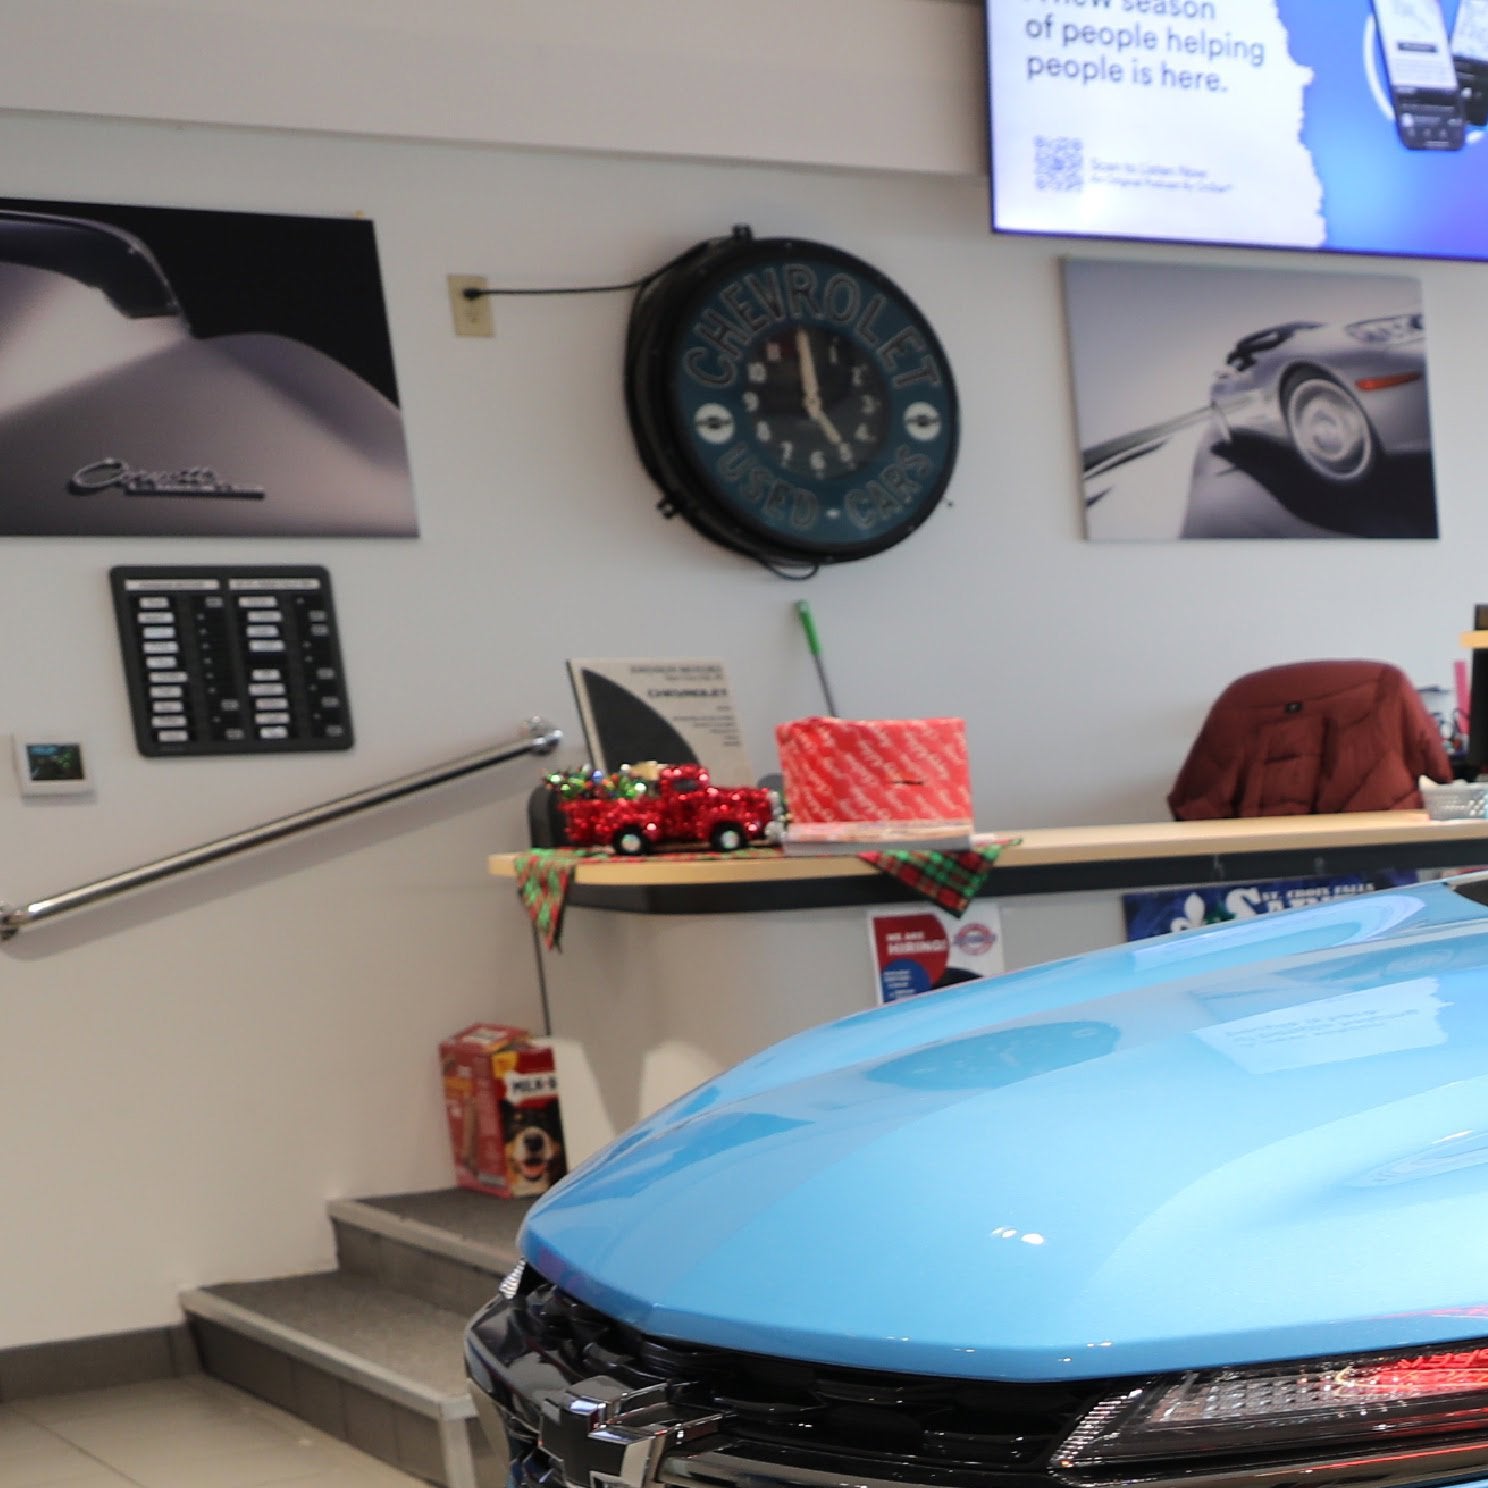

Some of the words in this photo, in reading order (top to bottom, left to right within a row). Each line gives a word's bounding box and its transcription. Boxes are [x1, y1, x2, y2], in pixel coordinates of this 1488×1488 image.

[1121, 0, 1215, 20] season
[1025, 13, 1053, 39] of
[1062, 22, 1158, 52] people
[1167, 25, 1265, 68] helping
[1027, 54, 1124, 85] people
[1132, 58, 1153, 86] is
[1161, 60, 1228, 92] here.
[683, 263, 943, 389] CHEVROLET
[717, 443, 819, 531] USED
[843, 445, 930, 531] CARS
